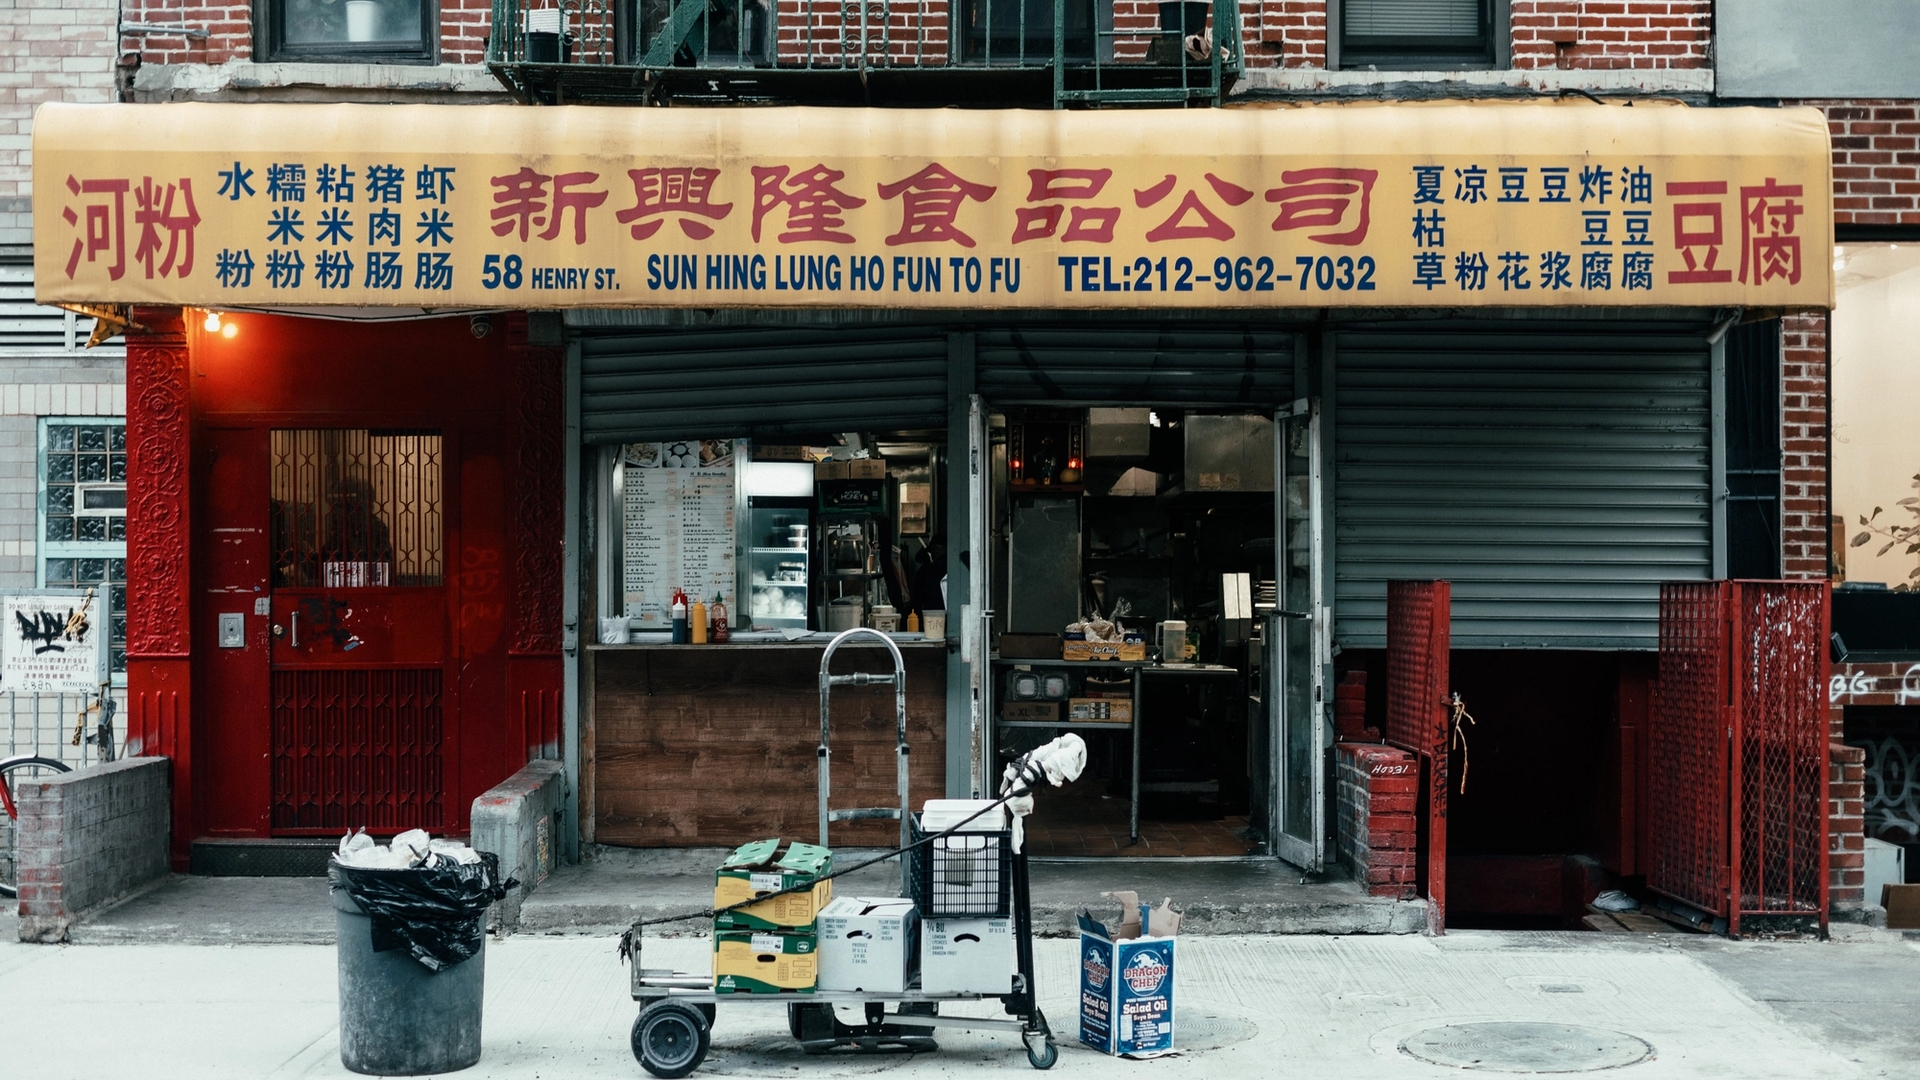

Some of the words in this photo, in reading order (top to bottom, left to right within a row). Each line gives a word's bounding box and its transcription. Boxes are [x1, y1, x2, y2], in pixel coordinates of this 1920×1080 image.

[63, 175, 201, 280] 河粉
[216, 163, 255, 288] 水粉
[266, 164, 306, 289] 糯米粉
[315, 164, 355, 289] 粘米粉
[365, 165, 404, 290] 猪肉肠
[415, 166, 455, 290] 虾米肠
[490, 163, 1379, 248] 新興隆食品公司
[1412, 166, 1446, 290] 夏枯草
[1455, 166, 1489, 290] 凉粉
[1498, 168, 1531, 290] 豆花
[1539, 168, 1573, 290] 豆浆
[1580, 166, 1612, 290] 炸豆腐
[1621, 167, 1653, 290] 油豆腐
[1666, 178, 1803, 286] 豆腐
[482, 254, 523, 290] 58
[531, 268, 589, 289] HENRY
[595, 268, 620, 290] ST.
[647, 254, 697, 290] SUN
[706, 254, 767, 290] HING
[775, 255, 842, 291] LUNG
[850, 255, 885, 291] HO
[893, 256, 941, 292] FUN
[949, 257, 982, 293] TO
[990, 257, 1021, 293] FU
[1058, 255, 1376, 292] TEL:212-962-7032
[936, 922, 947, 933] BU.
[1084, 959, 1110, 978] DRAGON
[1088, 971, 1106, 986] CHEF
[1124, 965, 1168, 980] DRAGON
[1083, 993, 1099, 1008] Salad
[1100, 1000, 1109, 1012] Oil
[1123, 1001, 1151, 1014] Salad
[1154, 1000, 1168, 1011] Oil
[1132, 978, 1160, 989] CHEF
